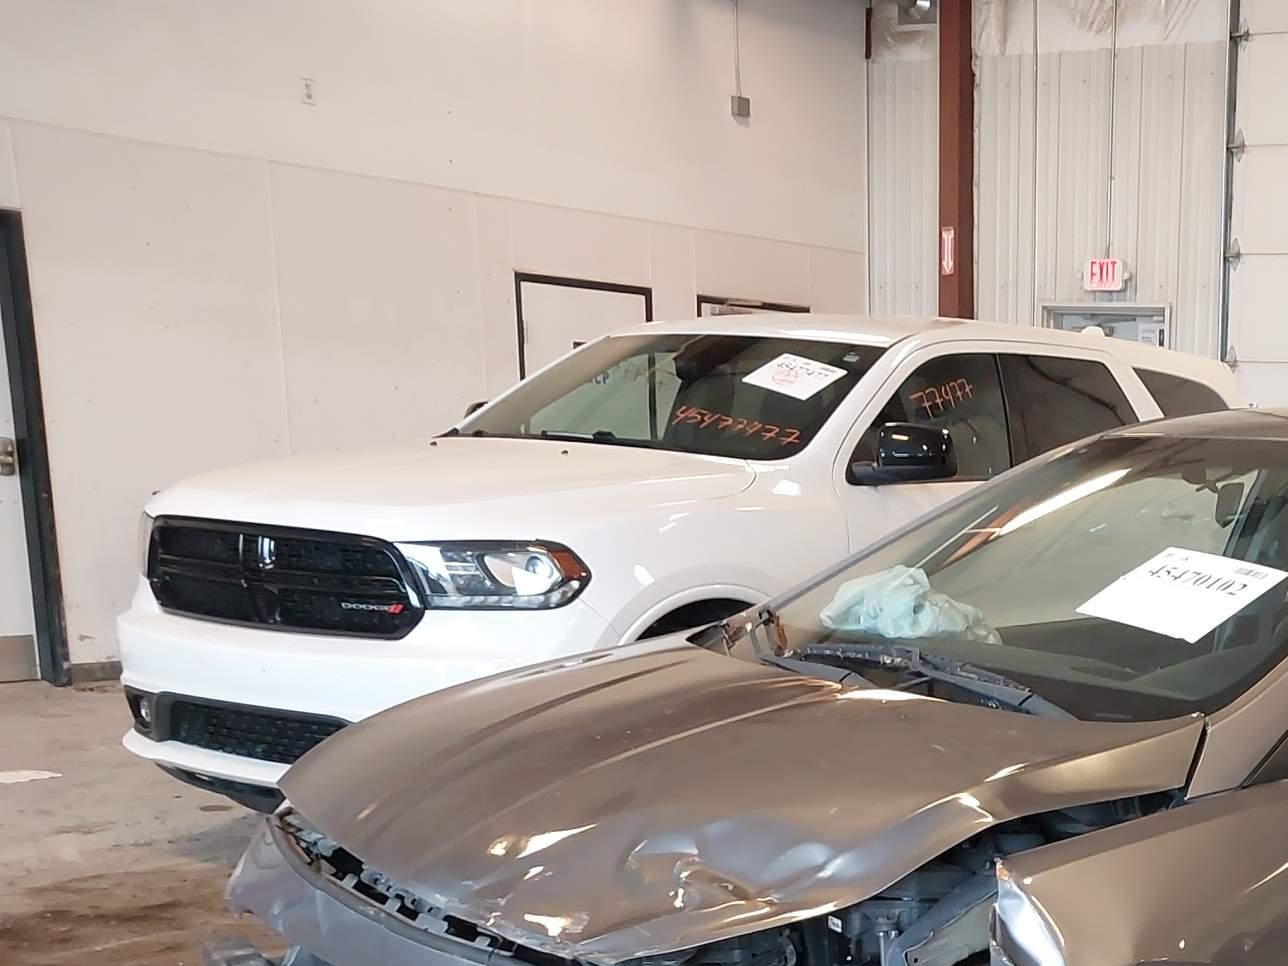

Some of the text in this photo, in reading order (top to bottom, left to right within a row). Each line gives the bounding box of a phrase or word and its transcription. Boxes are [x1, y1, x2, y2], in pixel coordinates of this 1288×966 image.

[1090, 260, 1117, 283] EXIT
[909, 378, 974, 419] 77477
[672, 405, 801, 446] 45477477
[1148, 564, 1249, 596] 45470102
